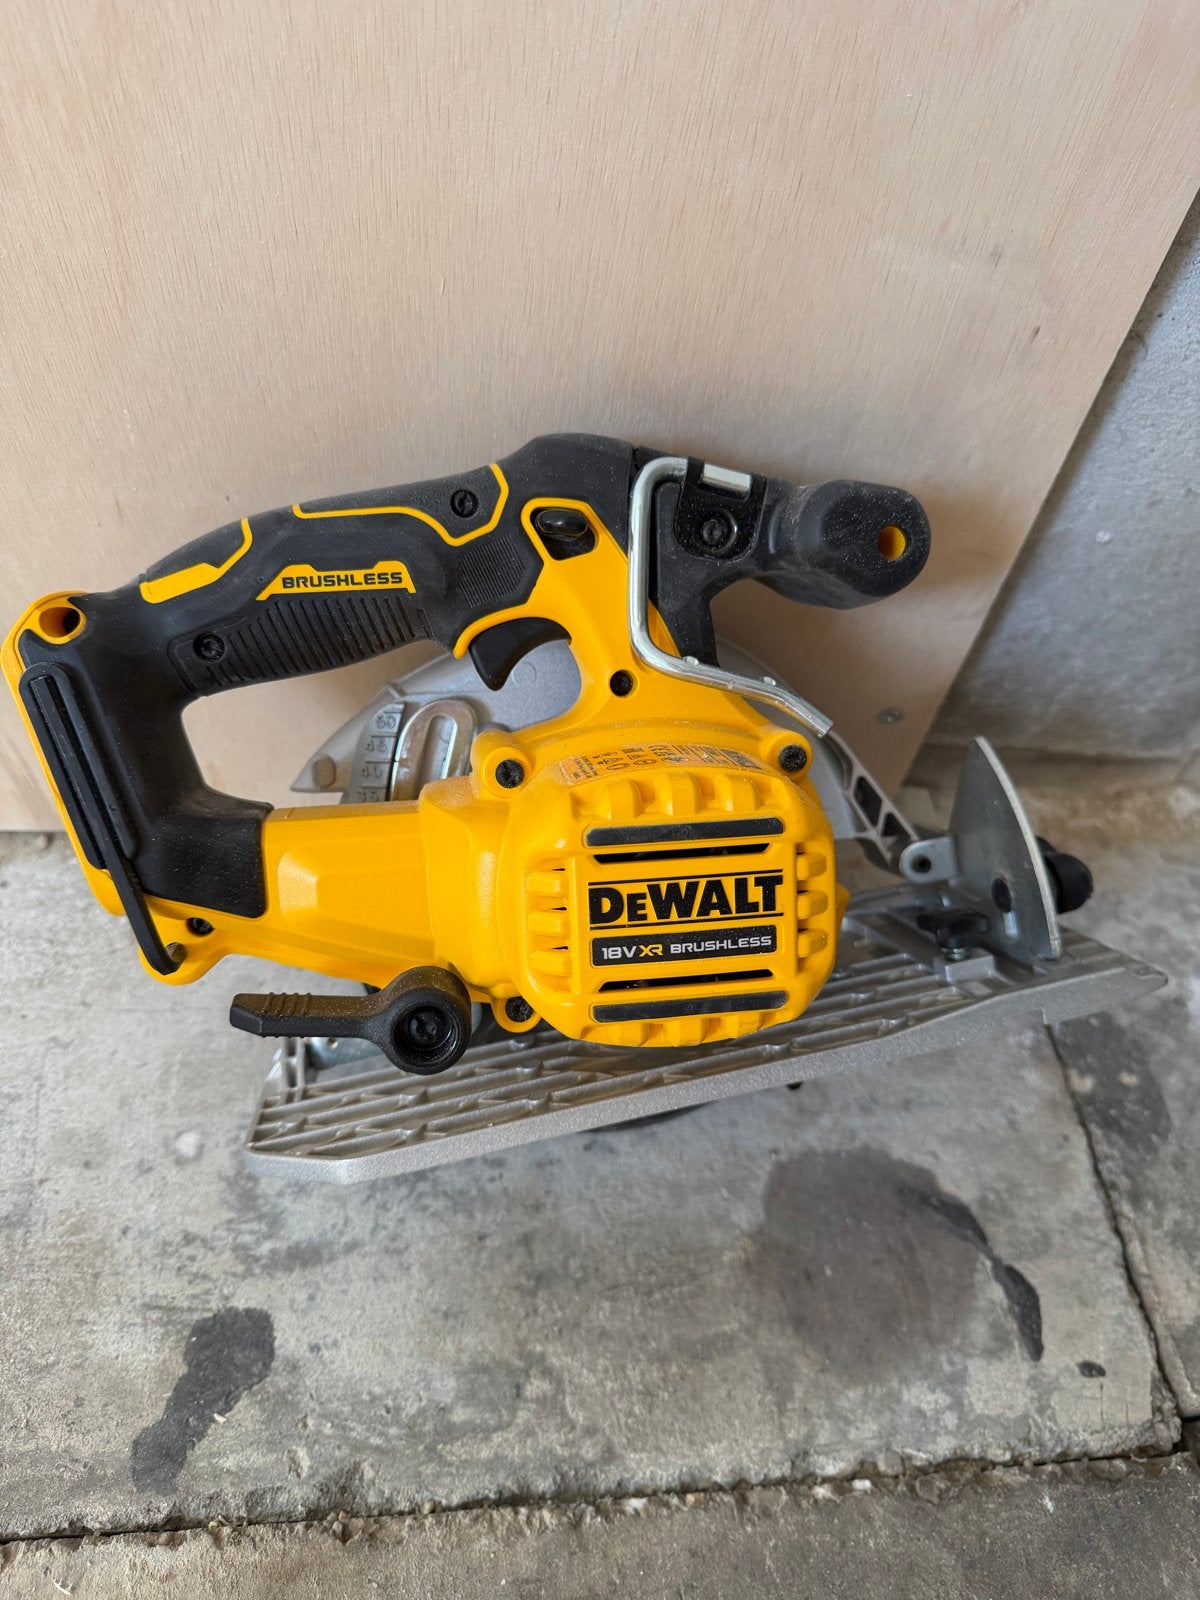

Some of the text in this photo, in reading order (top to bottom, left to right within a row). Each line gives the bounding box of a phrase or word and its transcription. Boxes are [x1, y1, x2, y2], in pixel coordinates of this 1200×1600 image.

[282, 572, 403, 589] BRUSHLESS
[377, 714, 397, 729] 50
[365, 738, 388, 753] 45
[361, 765, 382, 778] 40
[670, 936, 772, 954] BRUSHLESS
